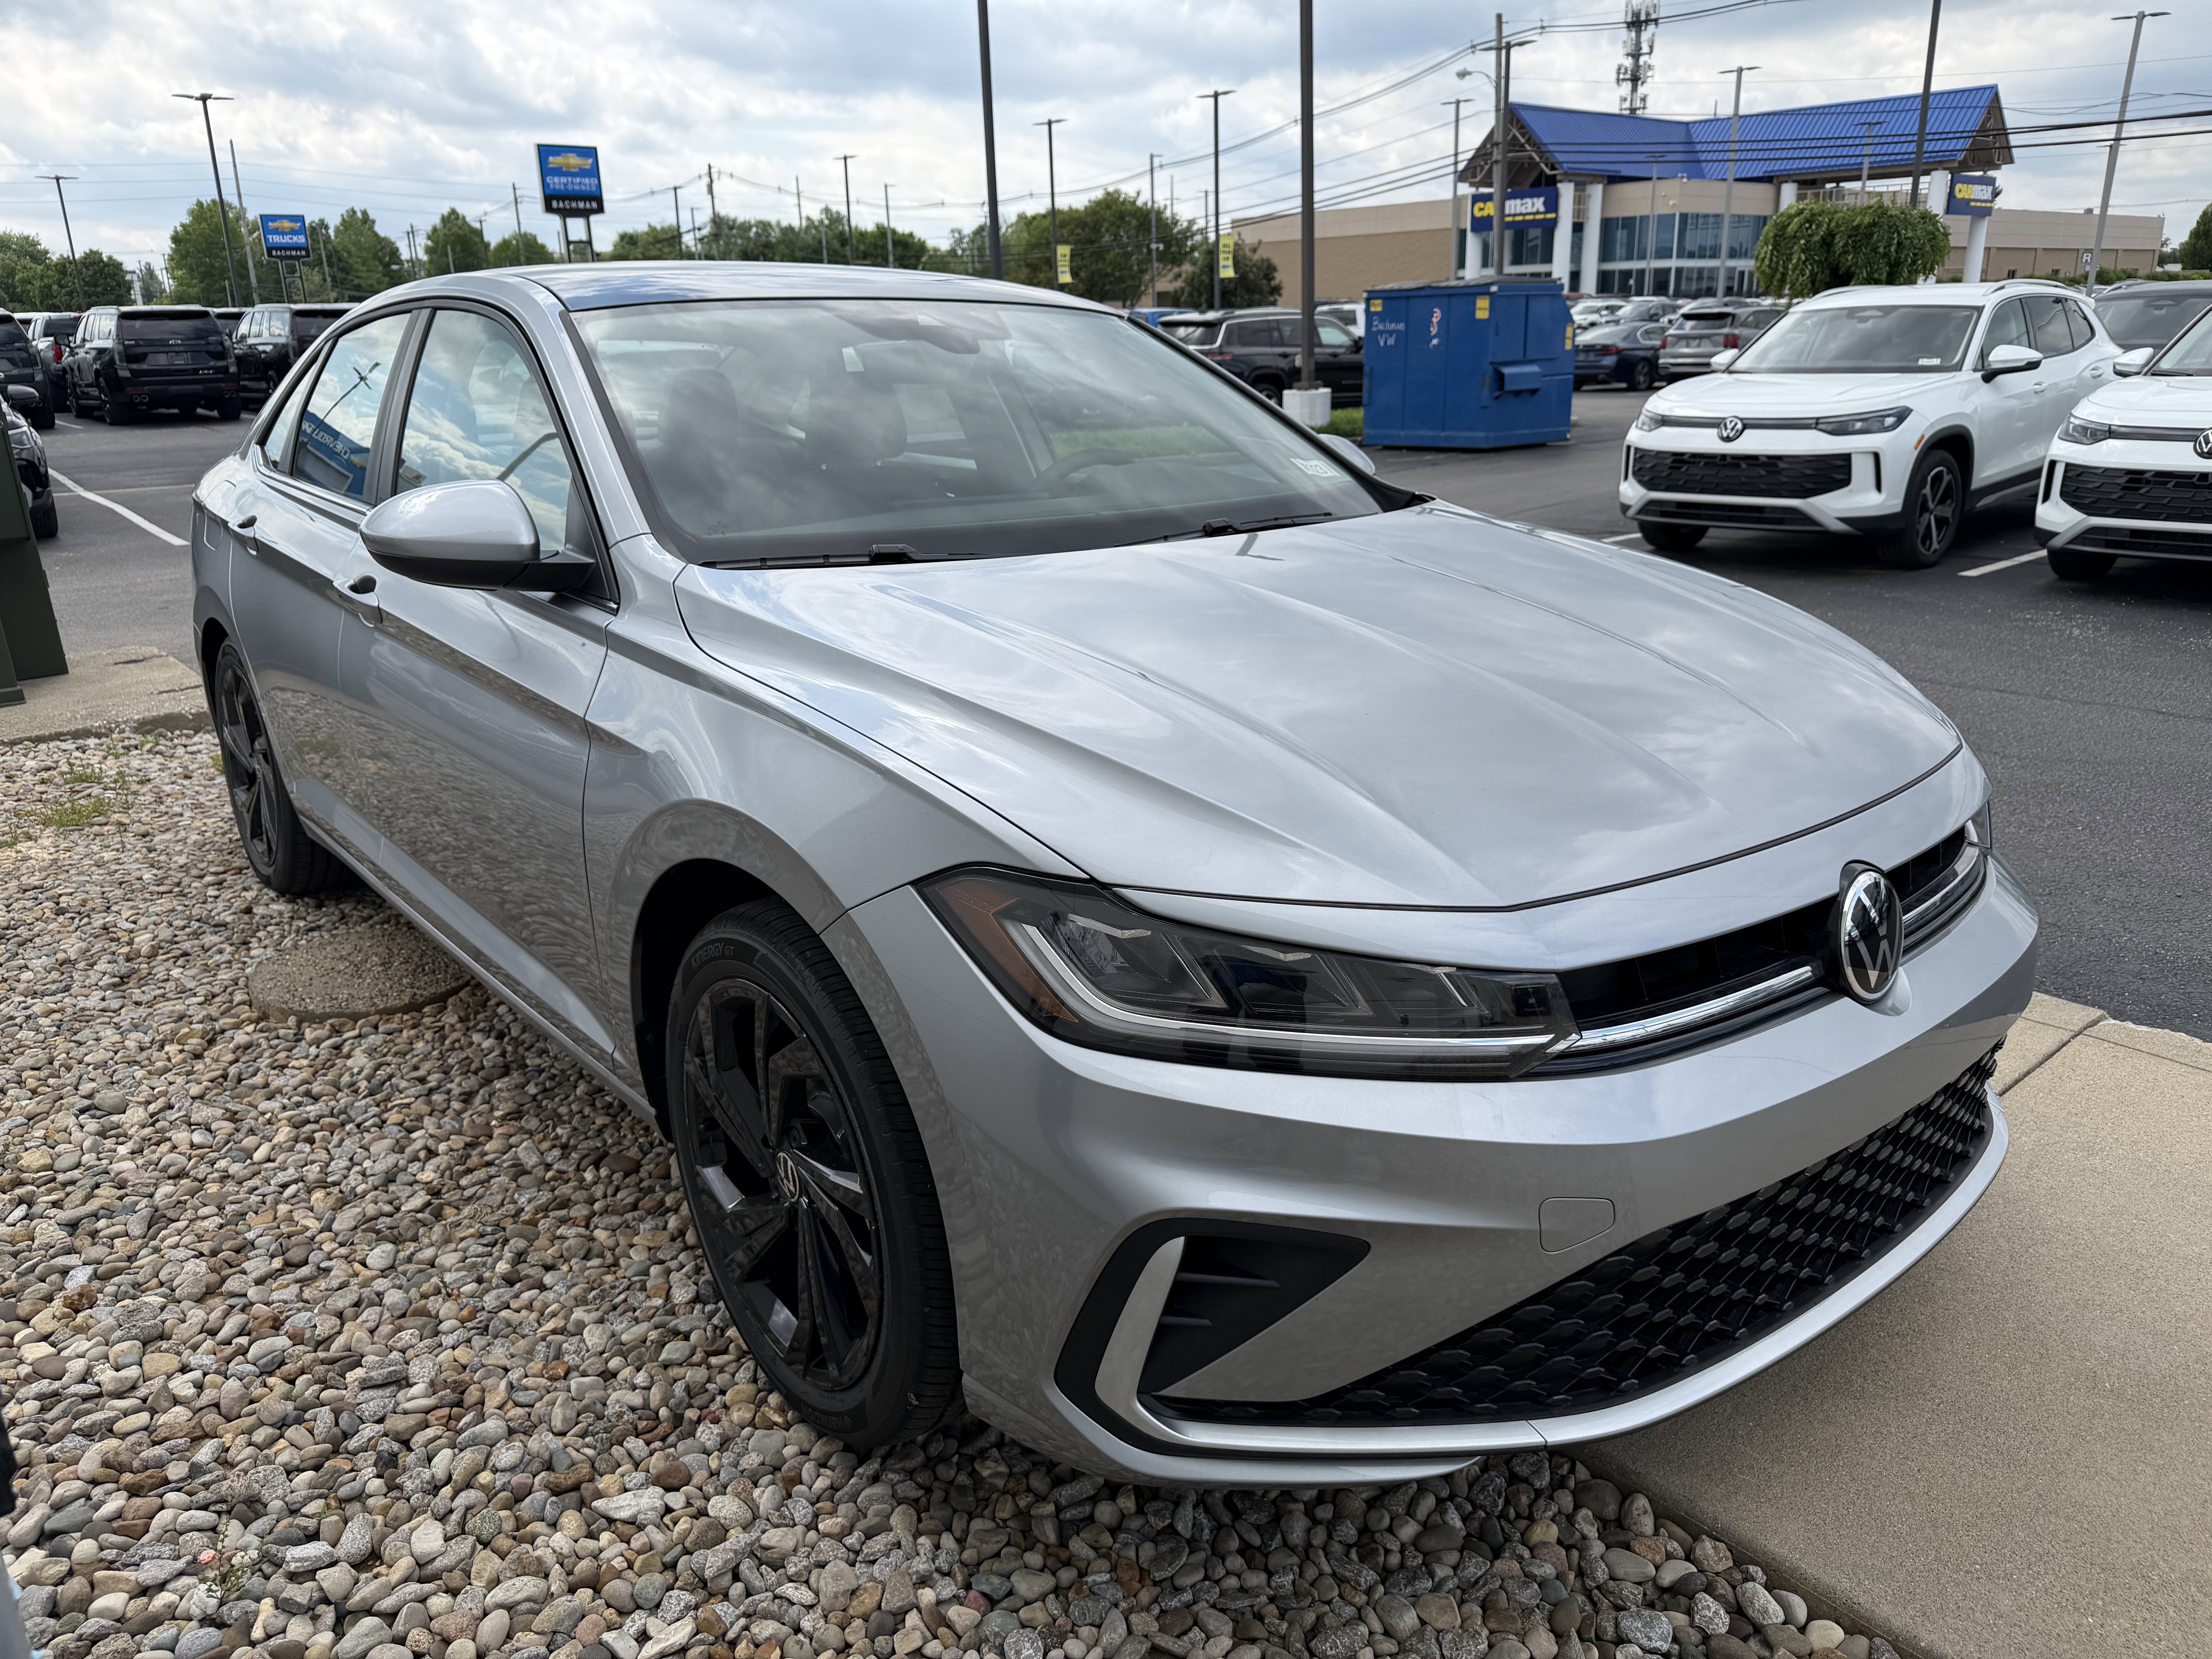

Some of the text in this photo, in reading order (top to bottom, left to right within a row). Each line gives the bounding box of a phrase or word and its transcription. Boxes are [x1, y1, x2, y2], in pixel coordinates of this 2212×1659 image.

[546, 176, 598, 184] CERTIFIED
[551, 199, 598, 209] BACHMAN
[1473, 196, 1546, 218] CAmax
[267, 235, 305, 243] TRUCKS
[725, 946, 734, 956] GT
